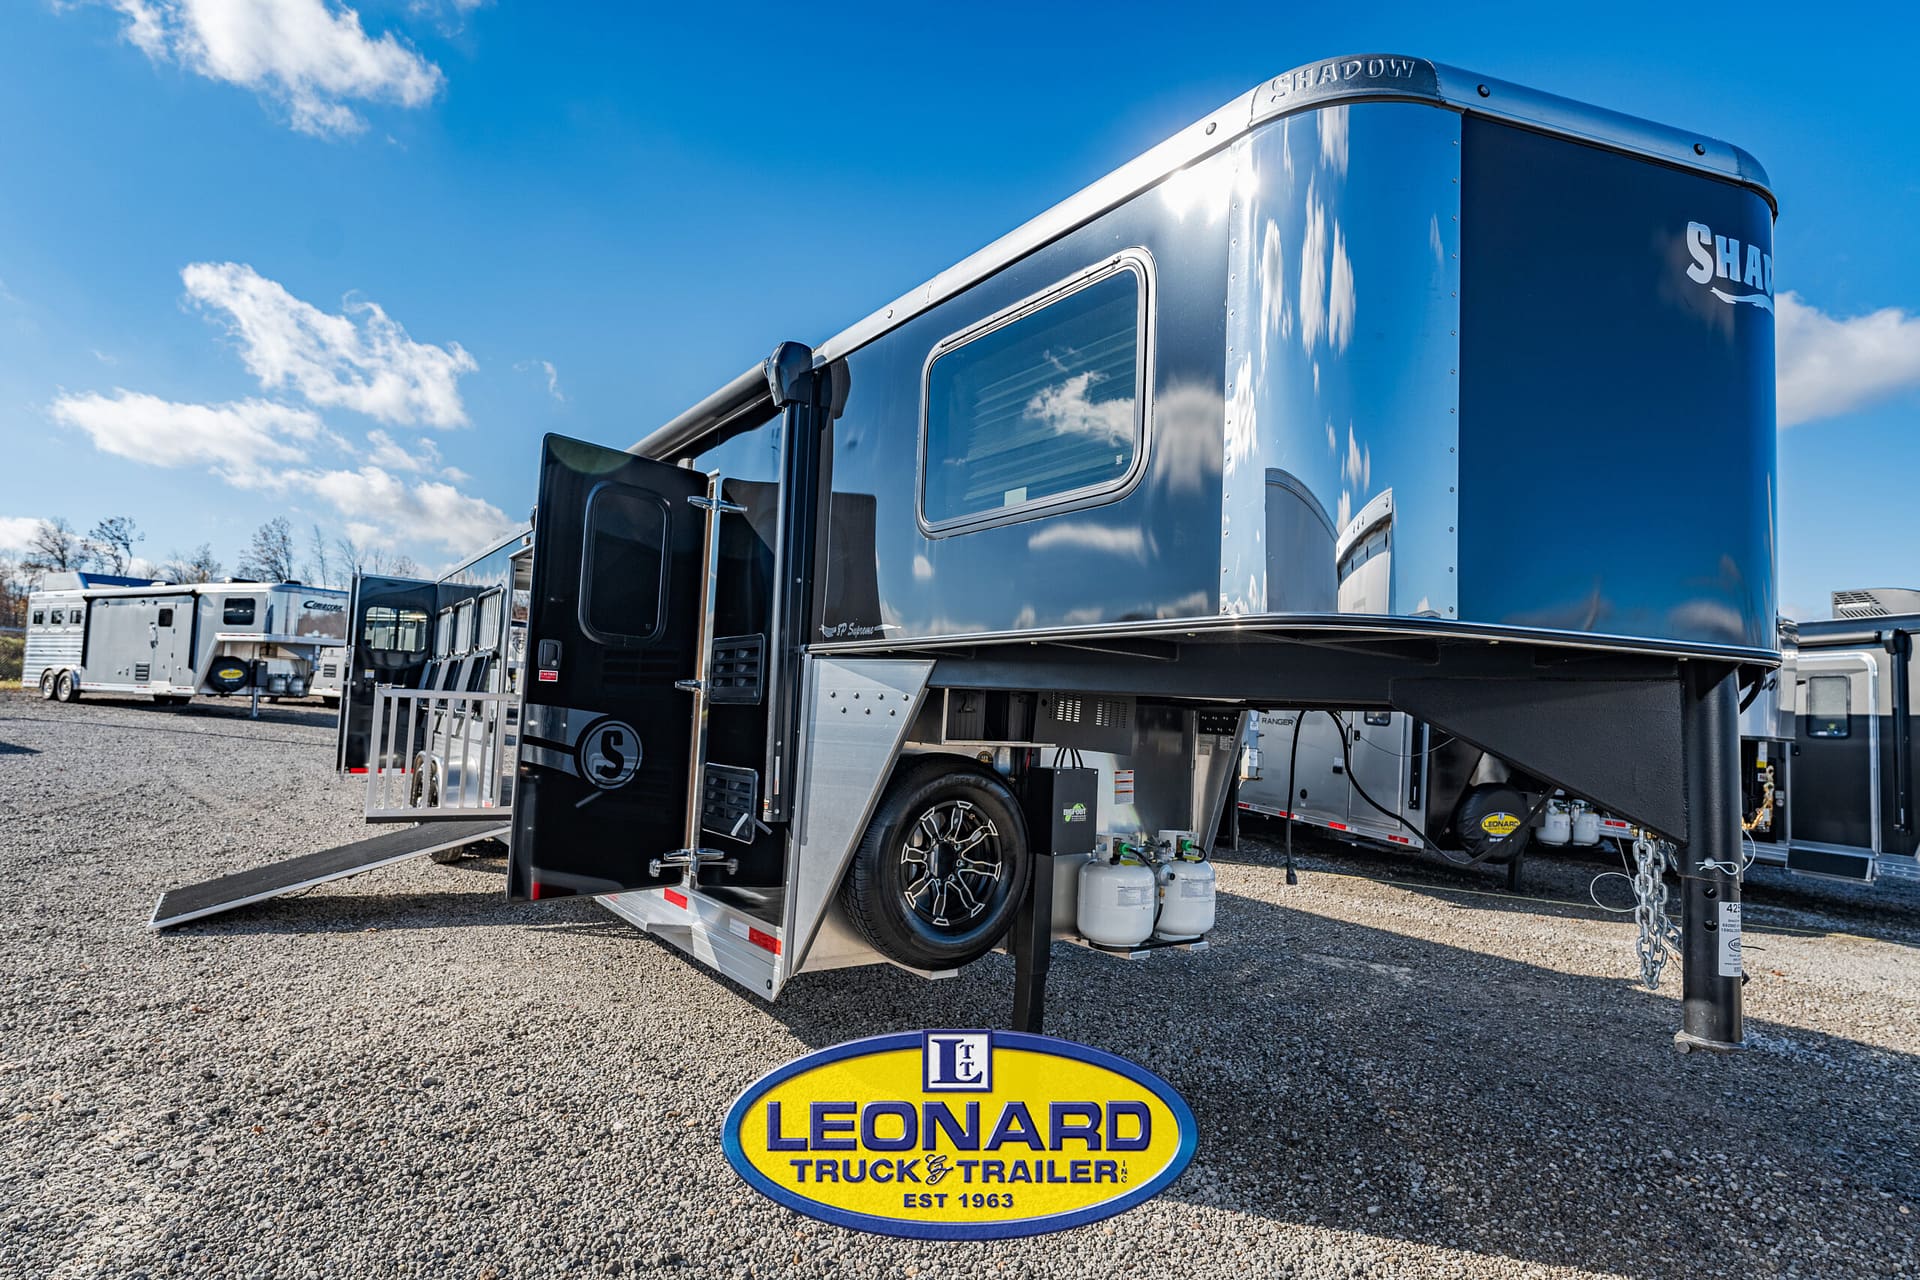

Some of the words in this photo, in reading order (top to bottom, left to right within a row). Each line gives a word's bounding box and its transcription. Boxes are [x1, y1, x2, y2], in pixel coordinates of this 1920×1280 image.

[1270, 58, 1416, 103] SHADOW
[1261, 717, 1294, 726] RANGER
[600, 730, 625, 779] S
